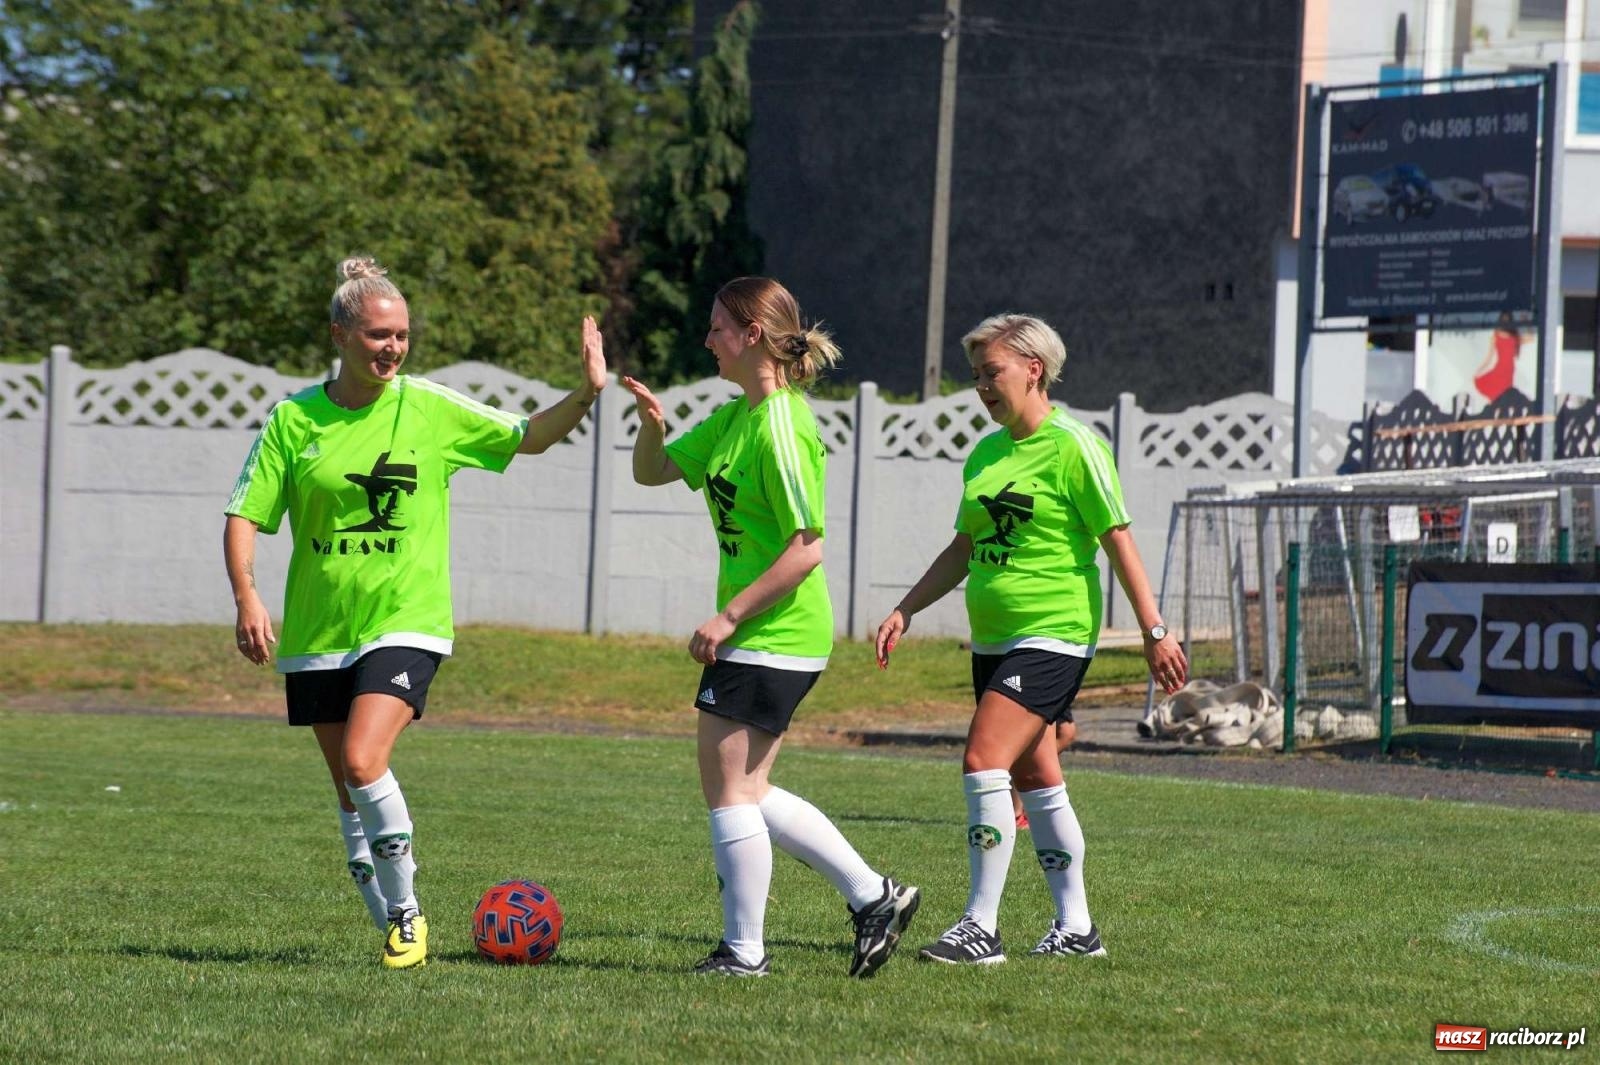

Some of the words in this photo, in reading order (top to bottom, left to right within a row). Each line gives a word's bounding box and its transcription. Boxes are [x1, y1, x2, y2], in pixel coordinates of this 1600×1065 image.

[1419, 118, 1444, 139] +48
[1447, 116, 1473, 138] 506
[1475, 114, 1498, 136] 501
[339, 537, 404, 556] BANK
[1496, 536, 1509, 555] D
[1485, 620, 1600, 672] zin
